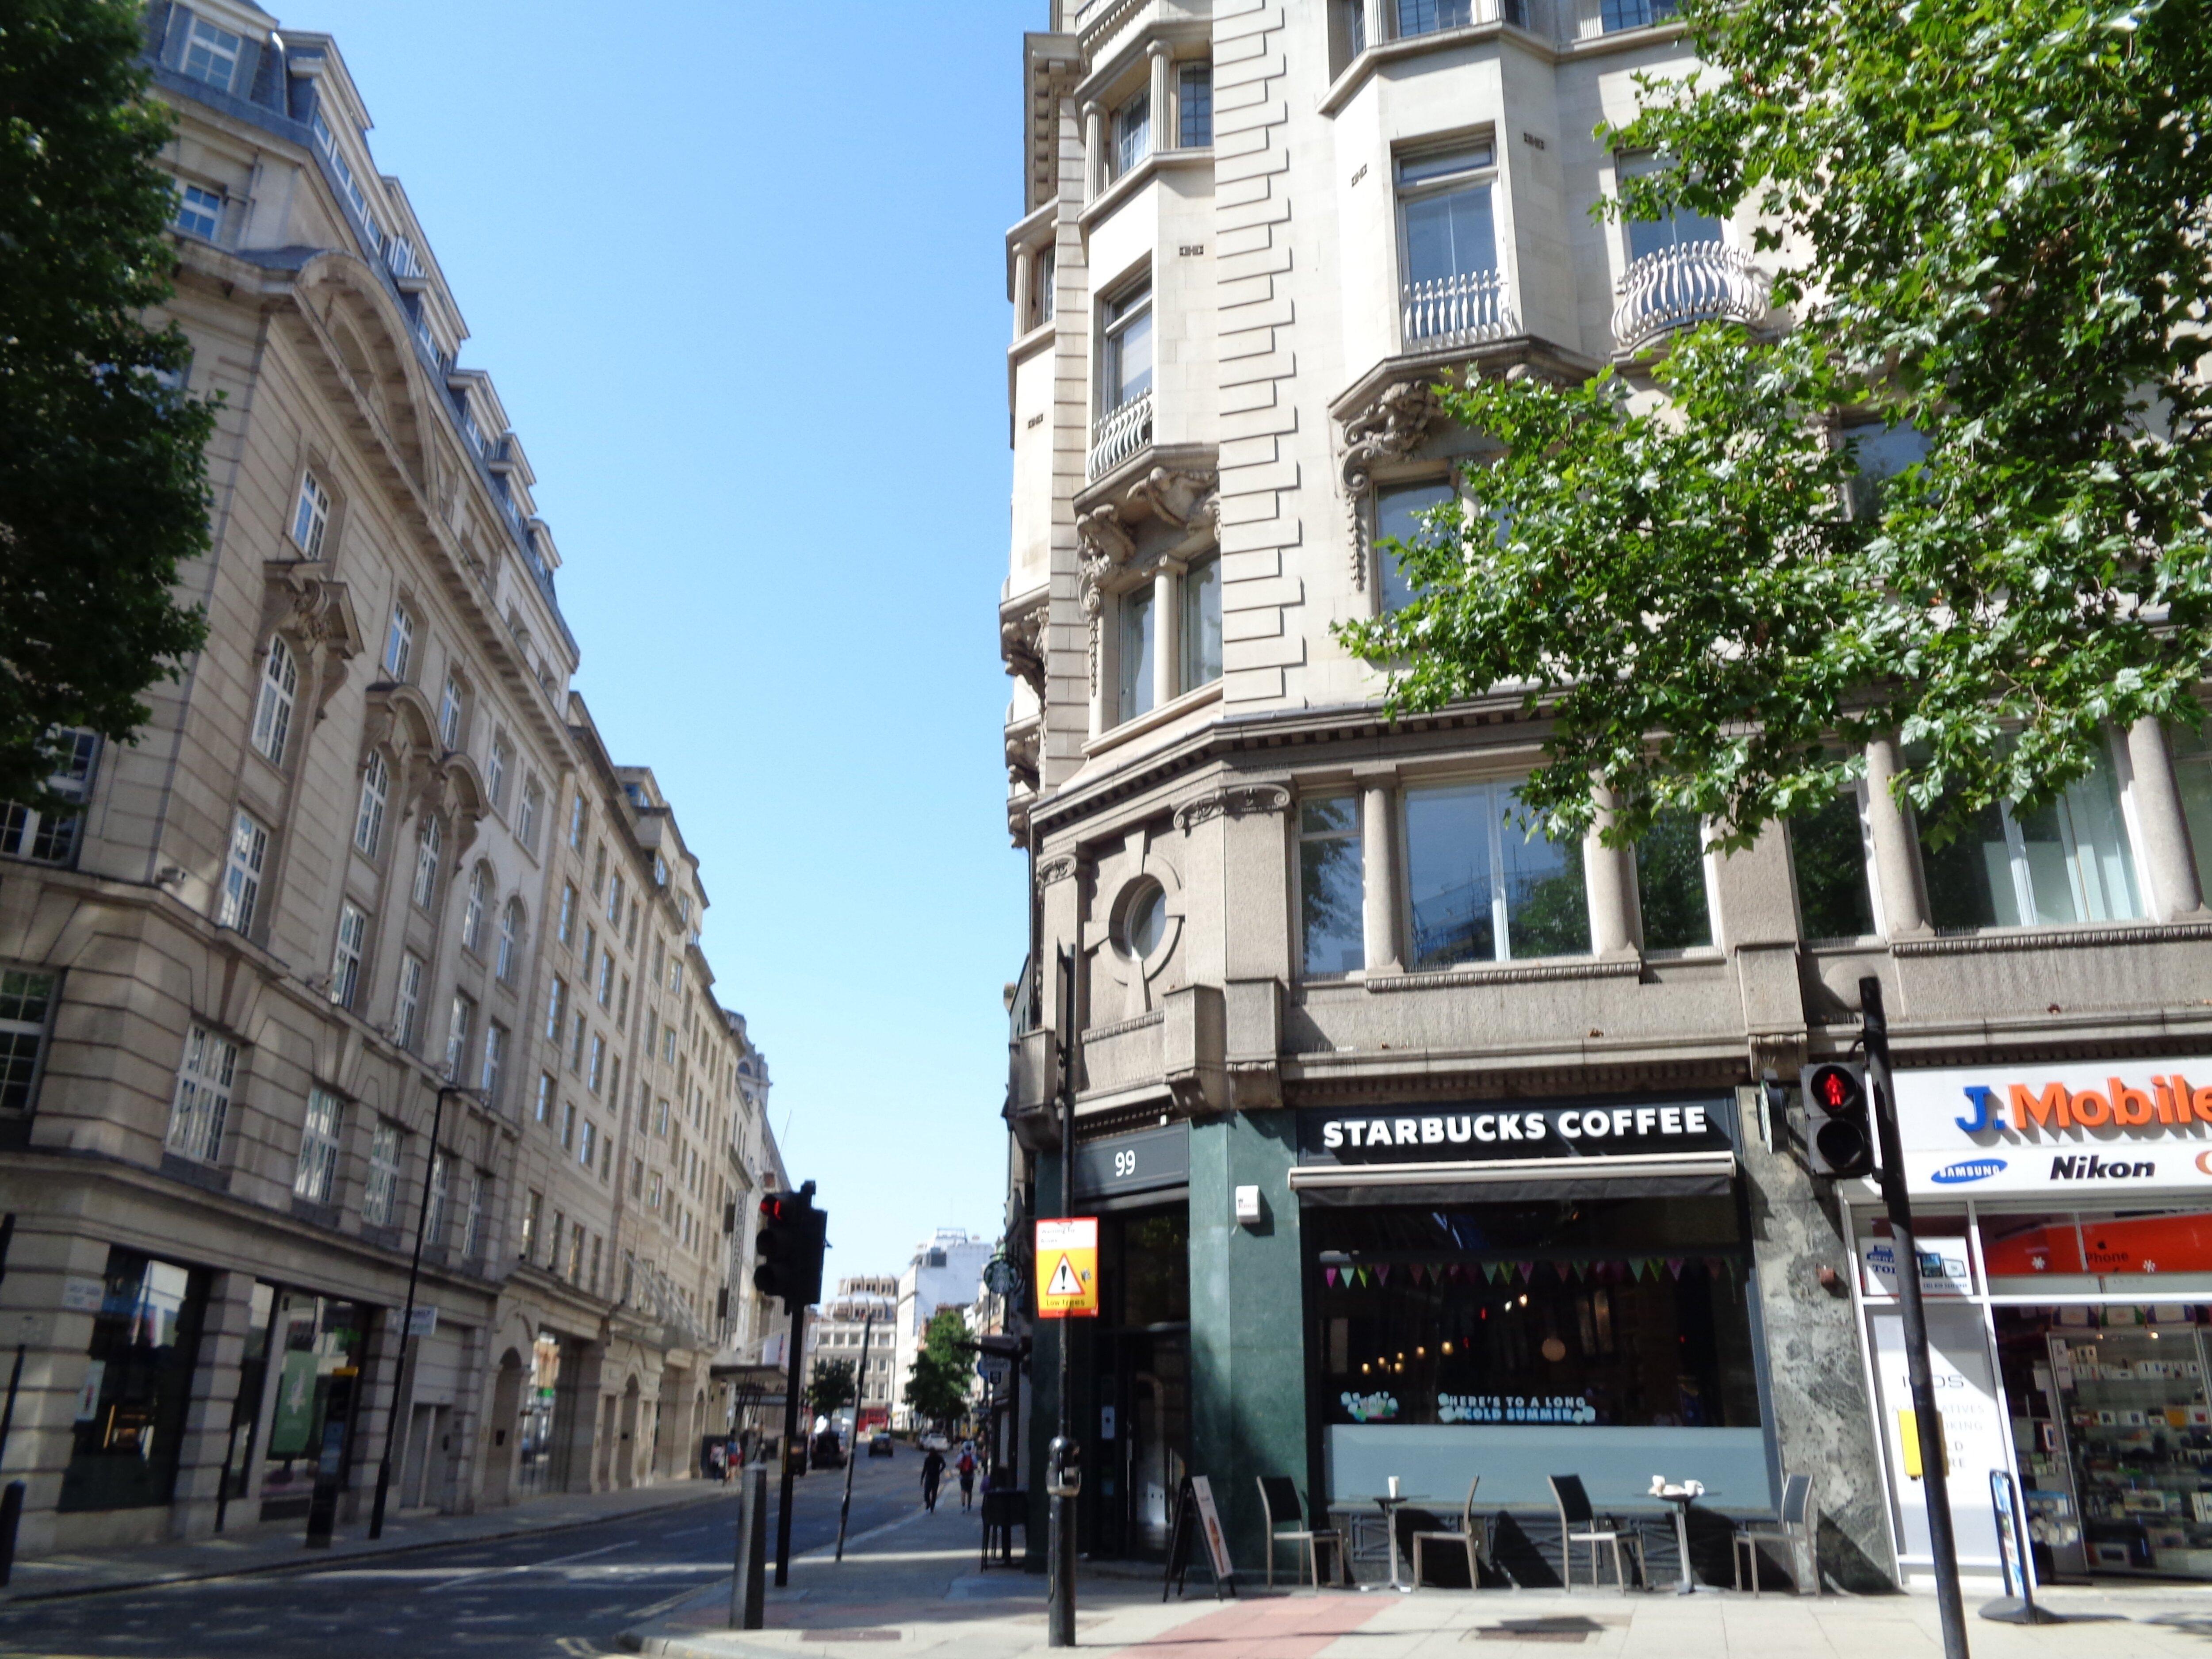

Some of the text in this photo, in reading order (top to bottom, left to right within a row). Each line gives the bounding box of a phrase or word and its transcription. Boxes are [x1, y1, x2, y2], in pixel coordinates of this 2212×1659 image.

[1323, 1106, 1707, 1147] STARBUCKS COFFEE
[1115, 1150, 1136, 1177] 99
[2050, 1154, 2156, 1180] Nikon
[1940, 1165, 2000, 1178] SAMSUNG
[1903, 1375, 1964, 1388] IOS
[1450, 1395, 1586, 1408] HERE'S TO A LONG
[1464, 1407, 1574, 1422] COLD SUMMER
